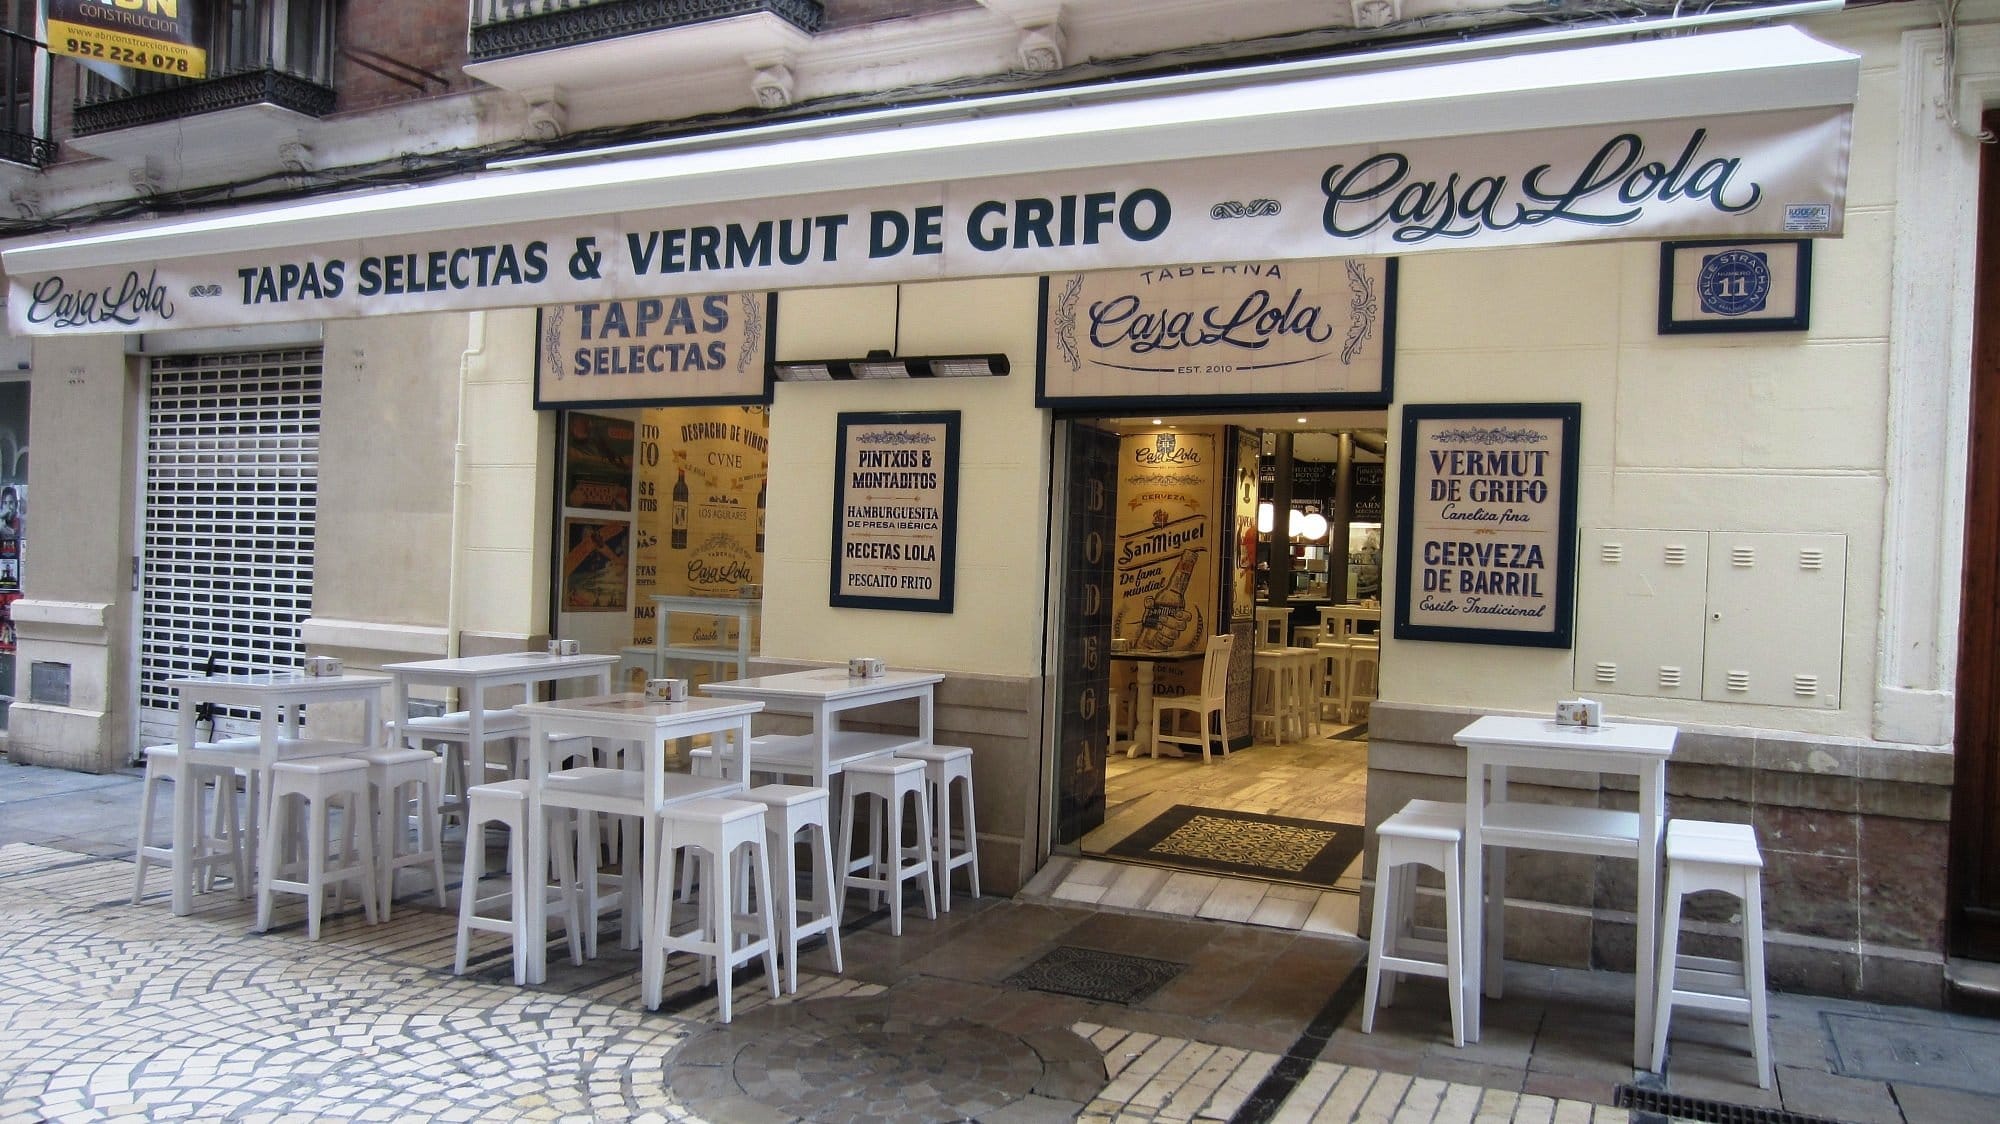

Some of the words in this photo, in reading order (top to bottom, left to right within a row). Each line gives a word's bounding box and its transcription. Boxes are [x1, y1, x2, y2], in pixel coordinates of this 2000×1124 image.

[67, 38, 104, 58] 952
[110, 46, 147, 65] 224
[152, 54, 188, 73] 078
[1321, 152, 1524, 244] Casa
[1518, 127, 1762, 226] Lola
[238, 258, 345, 305] TAPAS
[358, 240, 548, 296] SELECTAS
[568, 236, 602, 281] &
[627, 214, 850, 276] VERMUT
[868, 205, 943, 259] DE
[966, 187, 1172, 252] GRIFO
[27, 275, 103, 328] Casa
[101, 267, 174, 325] Lola
[1718, 276, 1749, 297] 11
[574, 294, 729, 341] TAPAS
[1088, 295, 1205, 353] Casa
[1201, 288, 1332, 349] Lola
[573, 340, 727, 377] SELECTAS
[1177, 365, 1202, 374] EST.
[1206, 364, 1233, 373] 2010
[681, 422, 727, 443] DESPACHO
[730, 424, 741, 443] DE
[744, 428, 768, 454] VINOS
[858, 450, 918, 468] PINTXOS
[921, 450, 932, 468] &
[1429, 450, 1550, 477] VERMUT
[852, 471, 937, 490] MONTADITOS
[1430, 479, 1461, 502] DE
[1469, 479, 1549, 504] GRIFO
[1141, 493, 1185, 501] CERVEZA
[847, 505, 939, 520] HAMBURGUESITA
[847, 520, 861, 528] DE
[862, 521, 895, 529] PRESA
[1441, 503, 1499, 522] Canelita
[1498, 508, 1531, 525] fina
[846, 542, 901, 560] RECETAS
[904, 544, 936, 562] LOLA
[1423, 540, 1545, 570] CERVEZA
[848, 573, 898, 588] PESCAITO
[901, 575, 932, 590] FRITO
[1423, 568, 1452, 593] DE
[1459, 570, 1544, 598] BARRIL
[1419, 595, 1459, 613] Estilo
[1462, 596, 1547, 618] Tradicional
